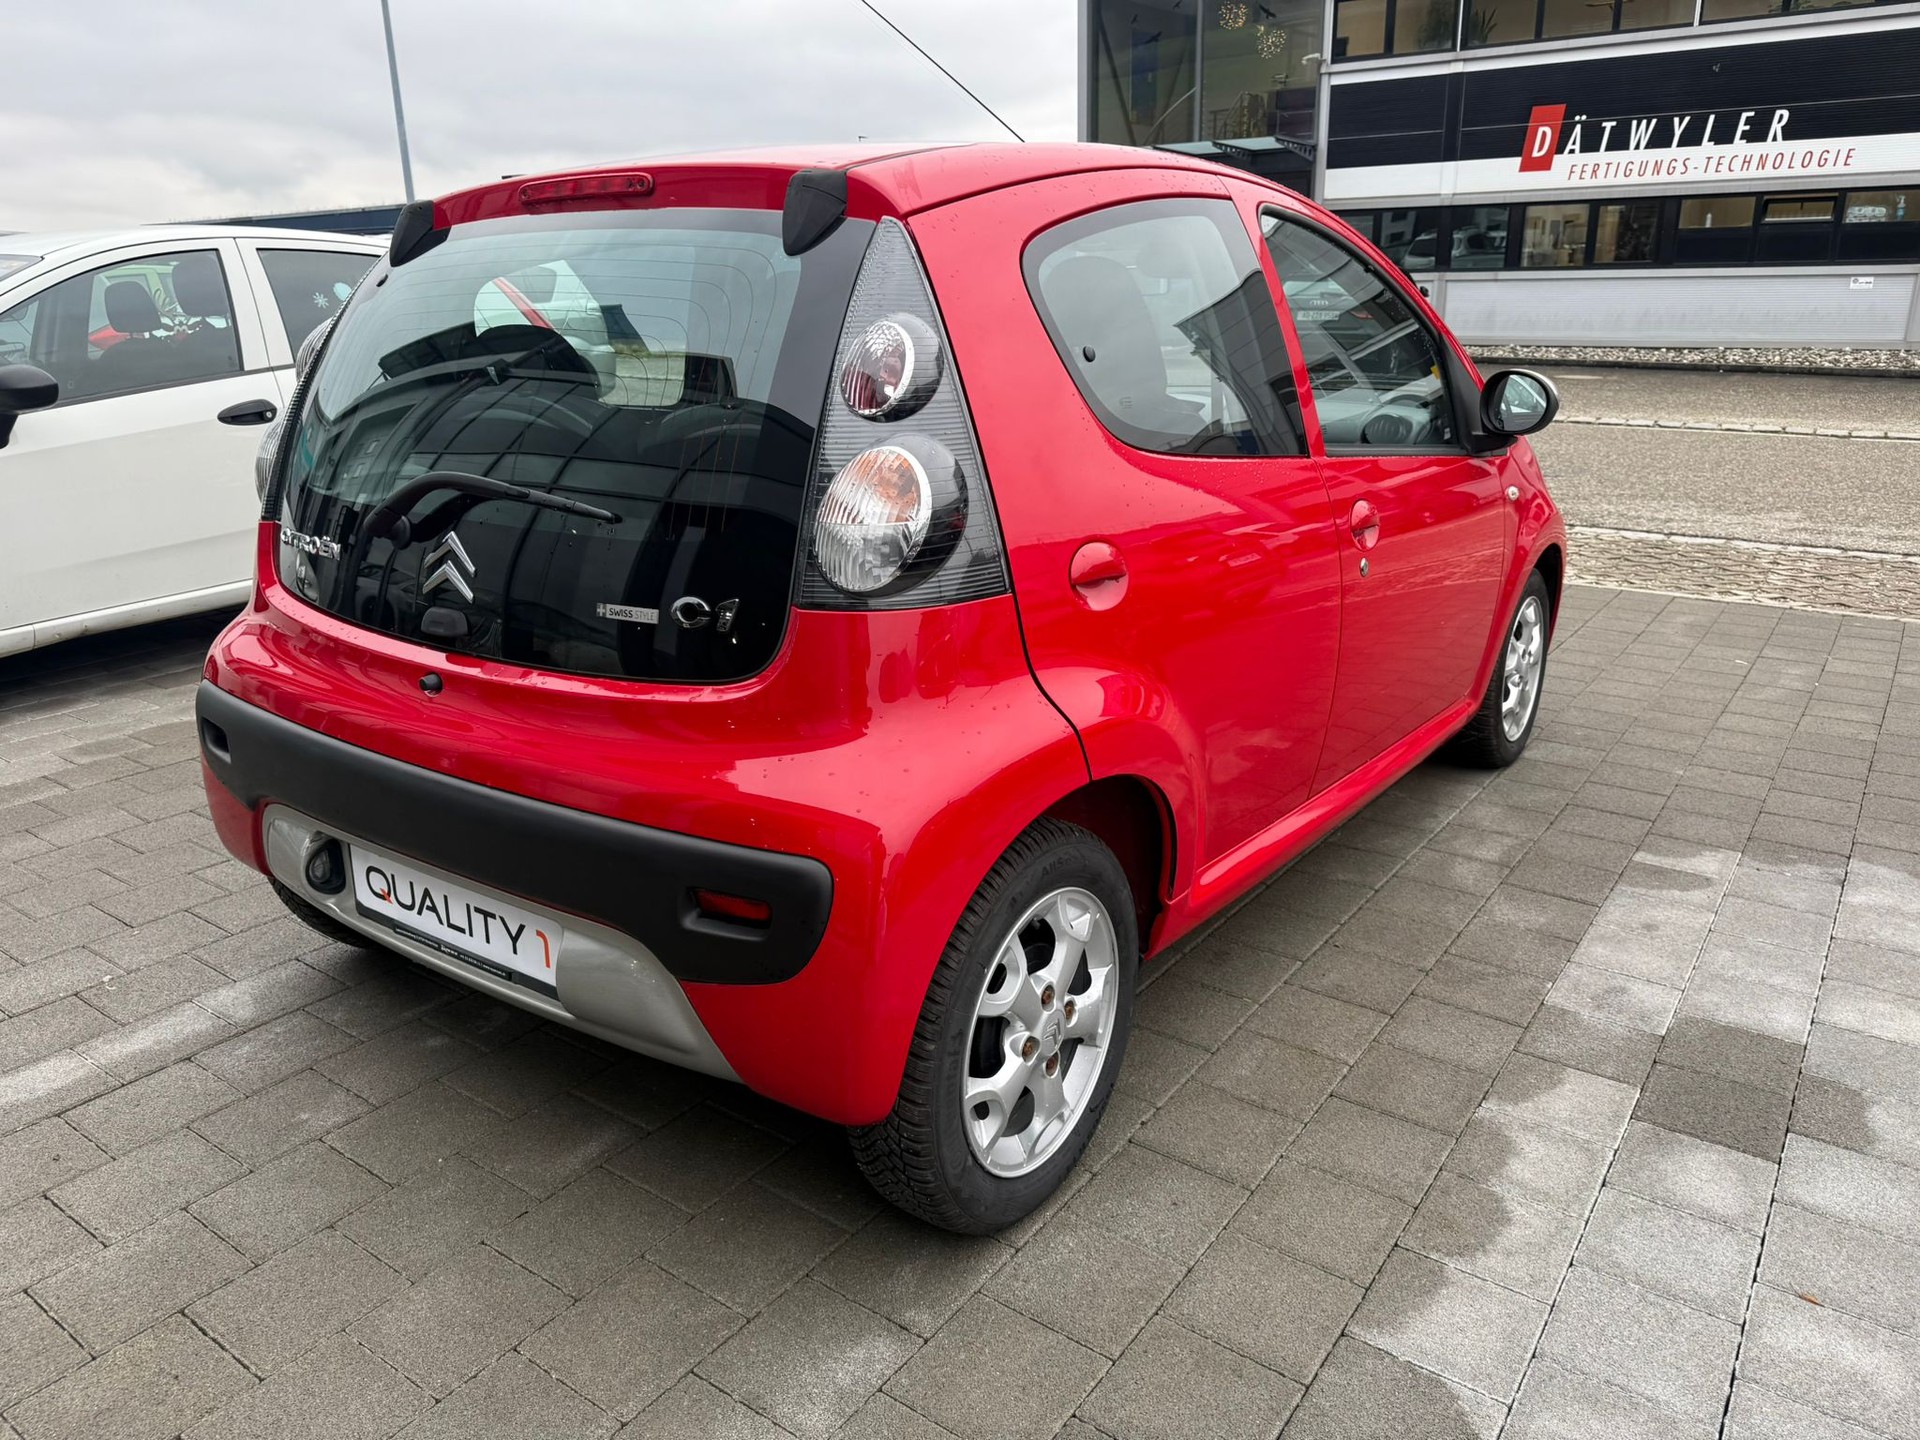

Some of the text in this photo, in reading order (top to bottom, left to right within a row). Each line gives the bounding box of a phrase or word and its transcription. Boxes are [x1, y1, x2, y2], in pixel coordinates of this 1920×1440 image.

[1531, 108, 1790, 158] DÄTWYLER
[1567, 147, 1857, 181] FERTIGUNGS-TECHNOLOGIE
[608, 607, 655, 621] SWISS STYLE
